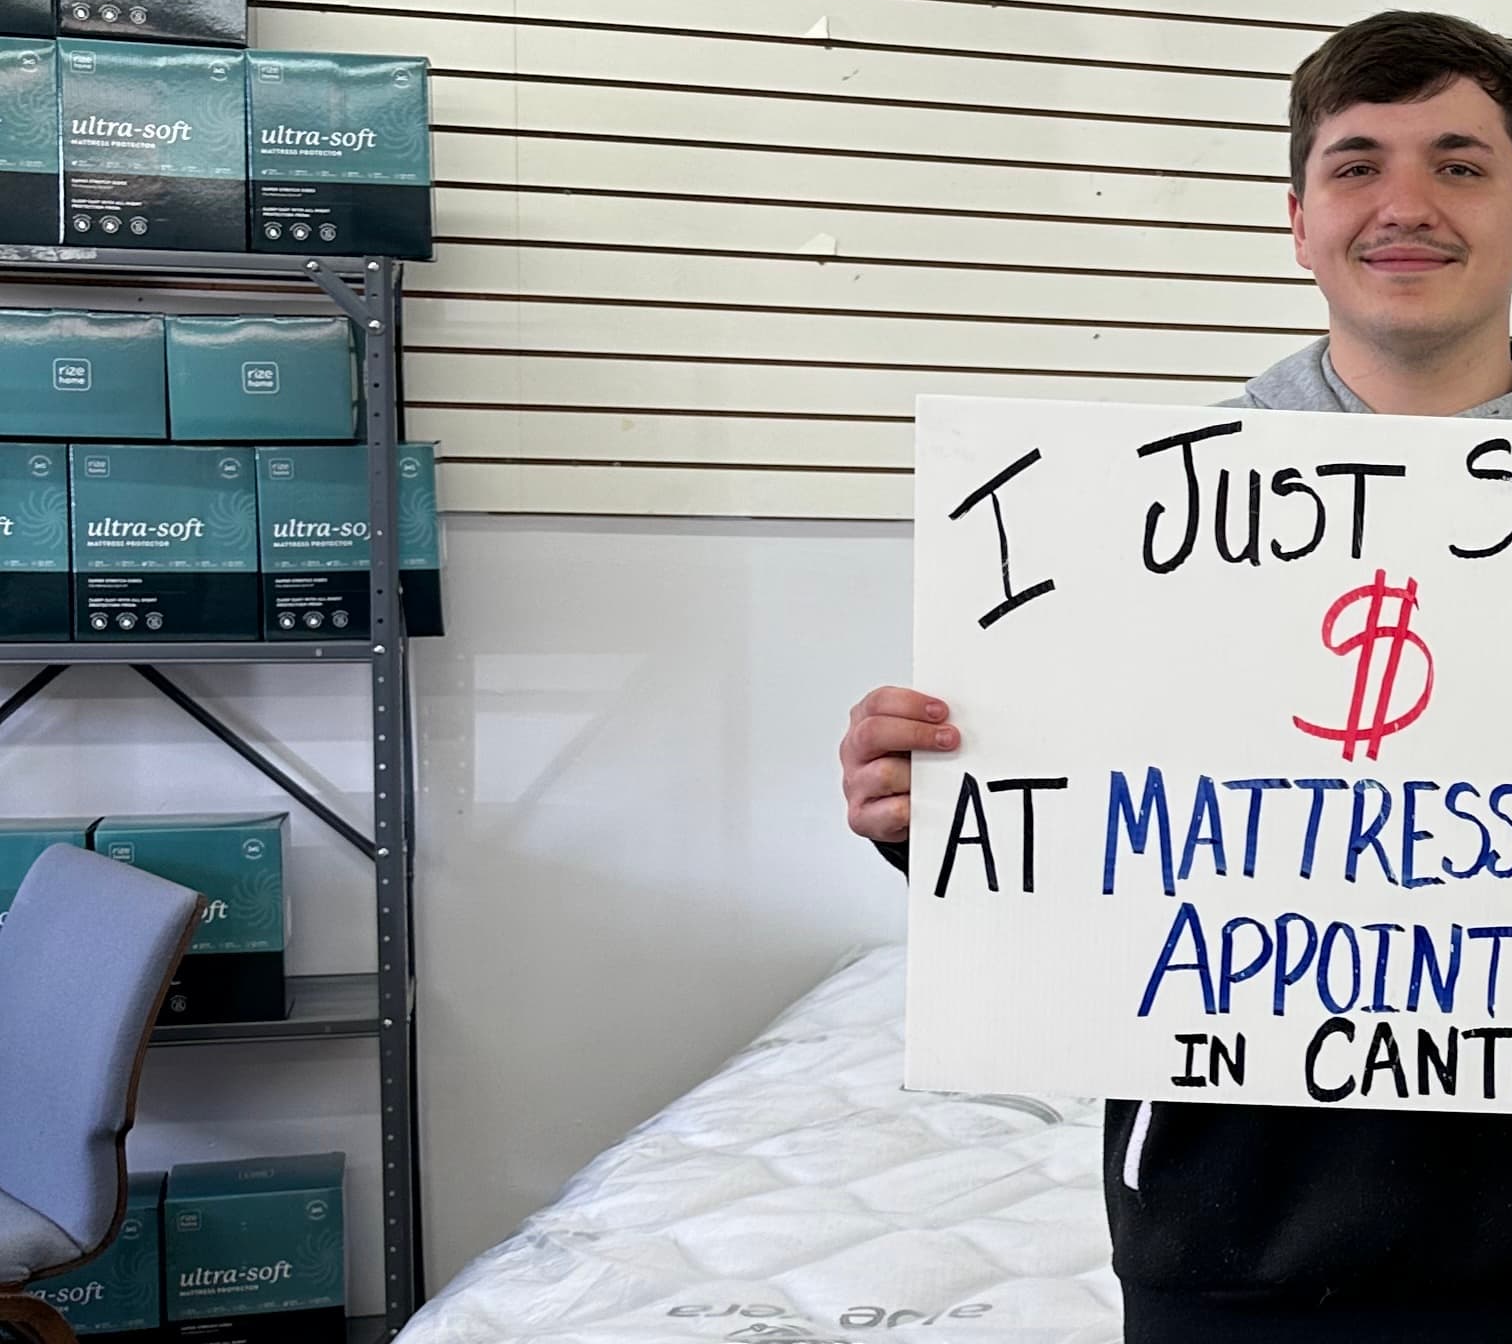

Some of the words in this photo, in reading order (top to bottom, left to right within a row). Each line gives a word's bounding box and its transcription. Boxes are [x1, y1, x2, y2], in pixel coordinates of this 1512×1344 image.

[71, 116, 192, 144] ultra-soft
[260, 125, 377, 151] ultra-soft
[88, 517, 205, 541] ultra-soft
[273, 519, 372, 540] ultra-so
[950, 449, 1055, 629] I
[1137, 421, 1406, 574] JUST
[1292, 569, 1435, 762] $
[934, 773, 1068, 898] AT
[1171, 1032, 1246, 1088] IN
[179, 1260, 293, 1288] ultra-soft
